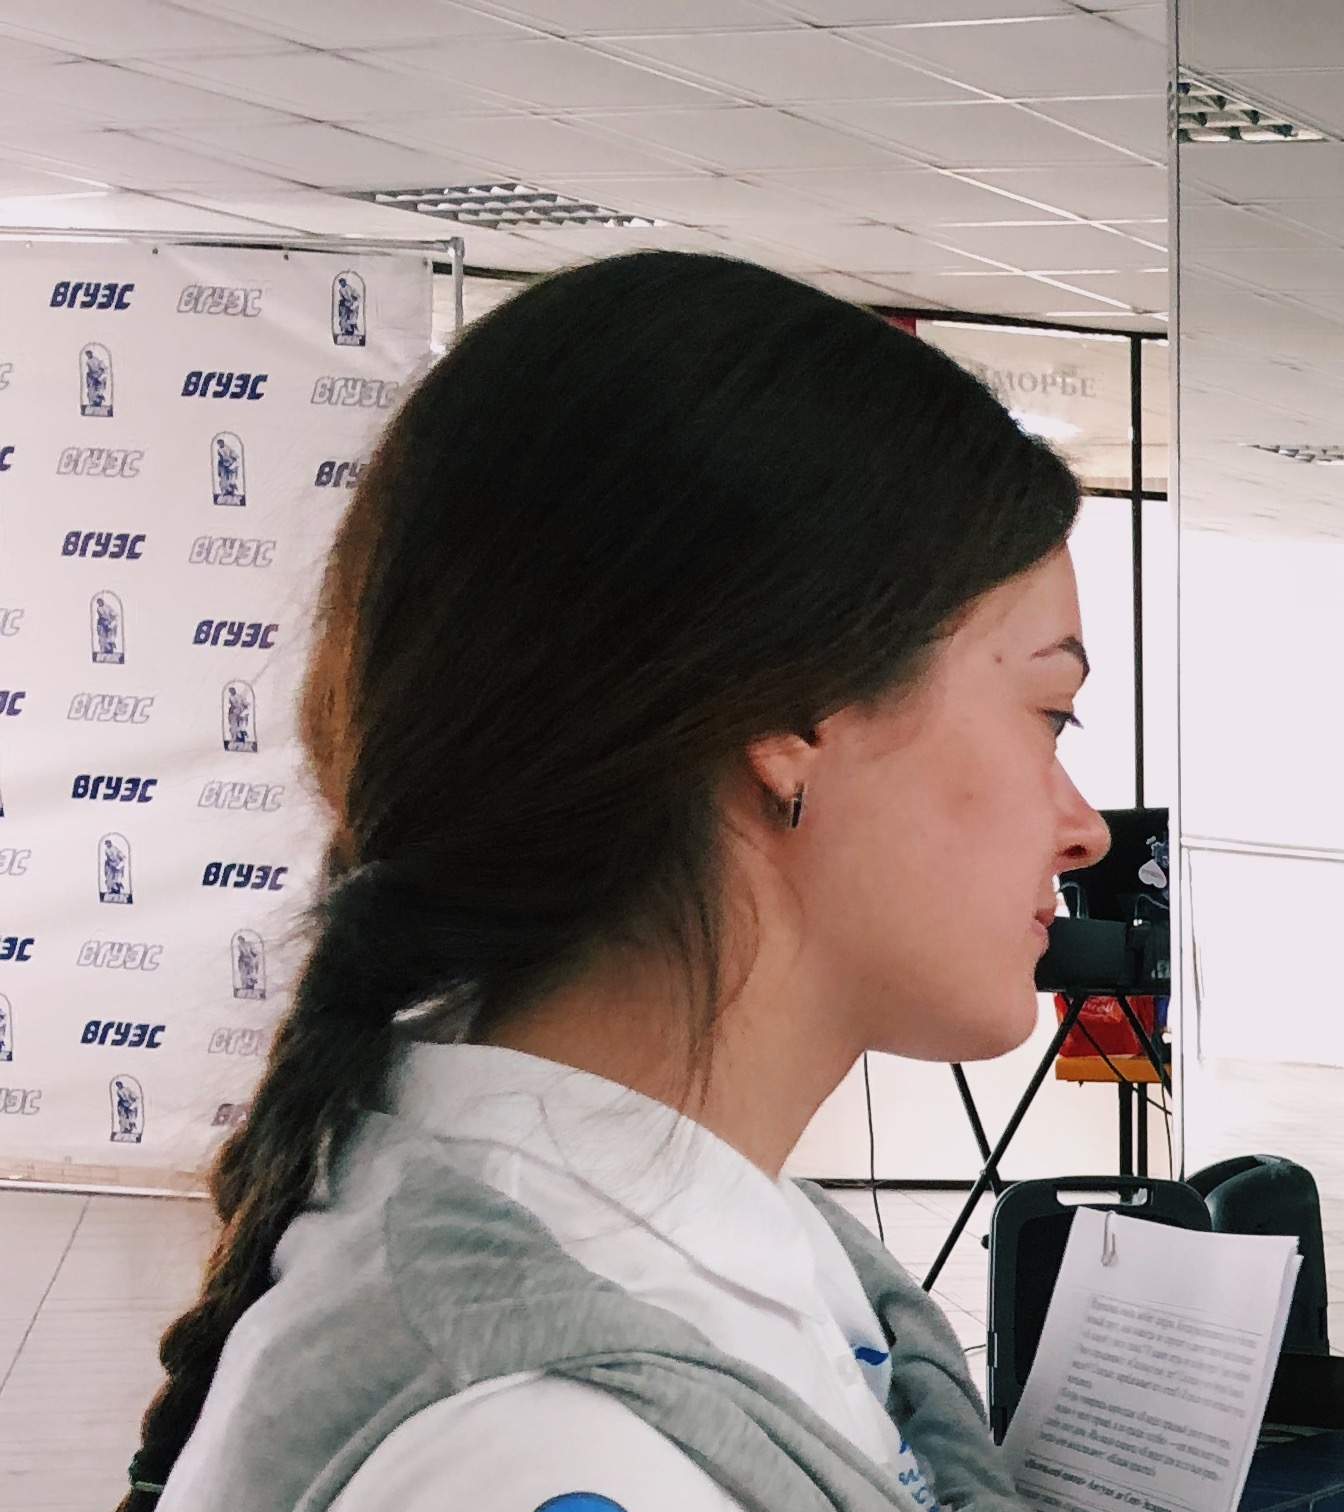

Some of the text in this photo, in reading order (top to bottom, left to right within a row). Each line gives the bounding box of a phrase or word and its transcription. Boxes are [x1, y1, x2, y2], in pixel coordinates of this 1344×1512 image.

[50, 281, 135, 311] ВГУЭС
[181, 371, 269, 401] ВГУЭС
[315, 460, 361, 488] ВГУ
[61, 531, 146, 560] ВГУЭС
[193, 619, 280, 650] ВГУЭС
[72, 774, 158, 803] ВГУЭС
[202, 862, 289, 891] ВГУЭС
[81, 1020, 166, 1049] ВГУЭС
